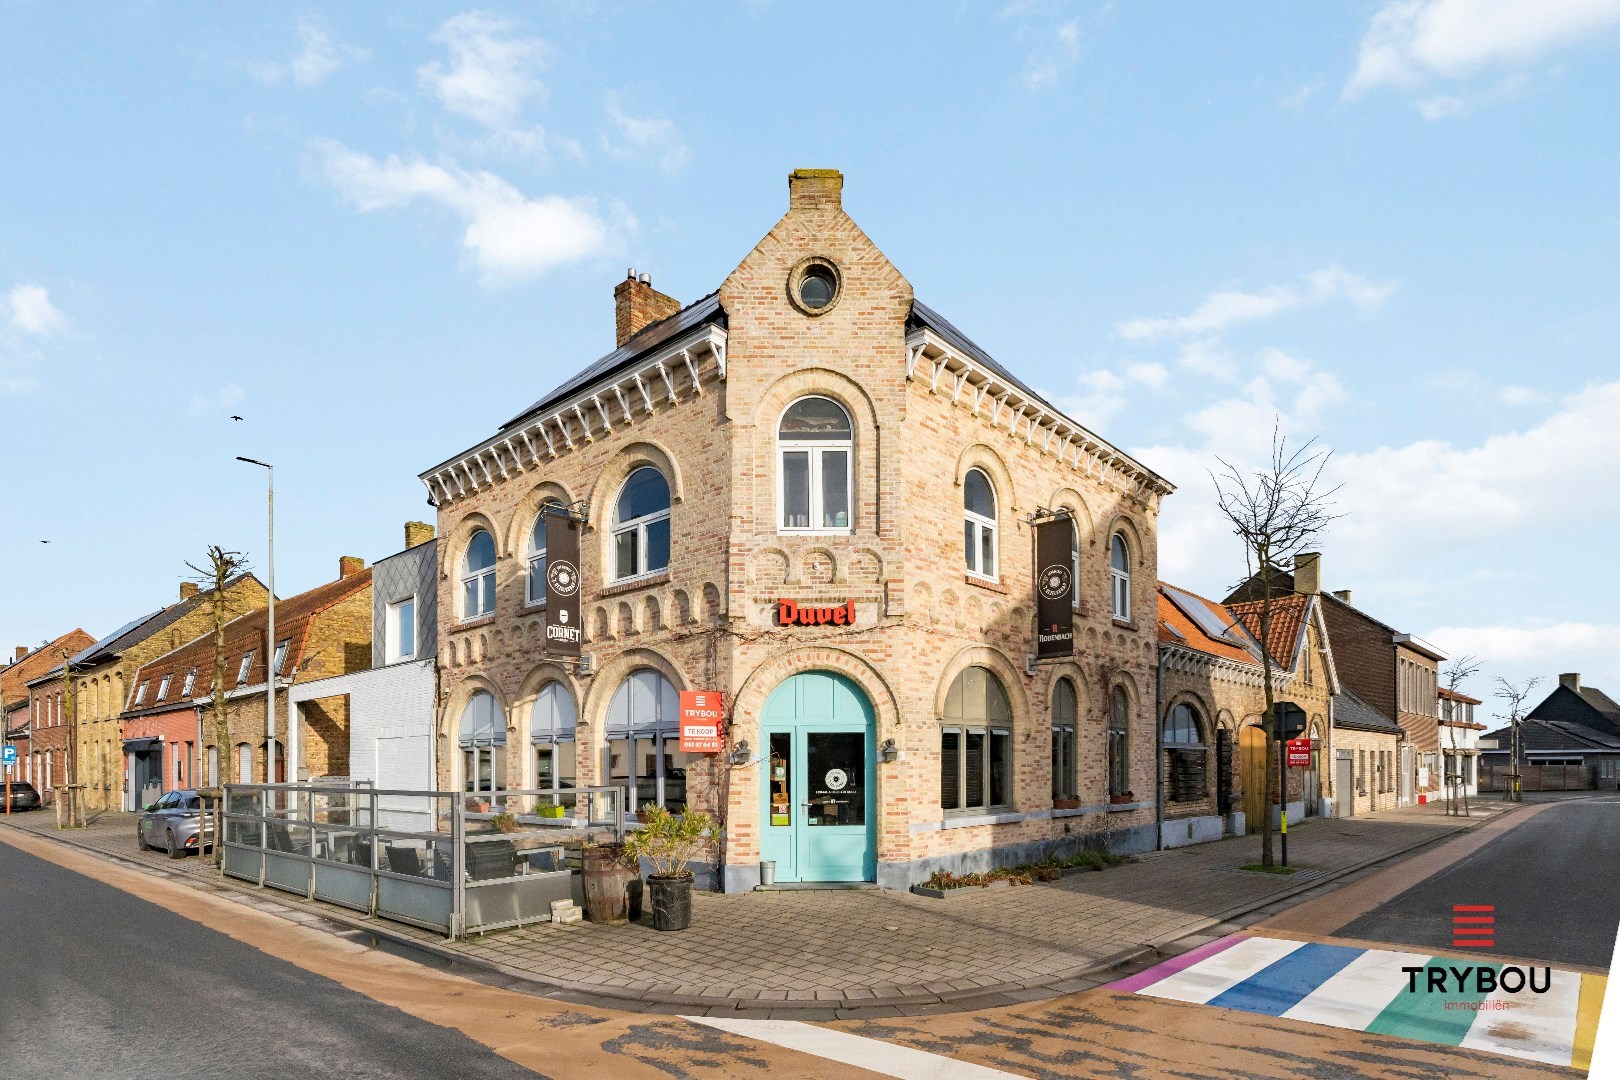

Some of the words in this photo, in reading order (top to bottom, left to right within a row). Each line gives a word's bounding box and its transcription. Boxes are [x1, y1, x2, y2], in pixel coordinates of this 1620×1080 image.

[777, 597, 856, 625] Duvel
[546, 626, 580, 642] CORNET
[1039, 633, 1072, 642] RODENBACH
[684, 710, 718, 718] TRYBOU
[4, 748, 15, 759] P
